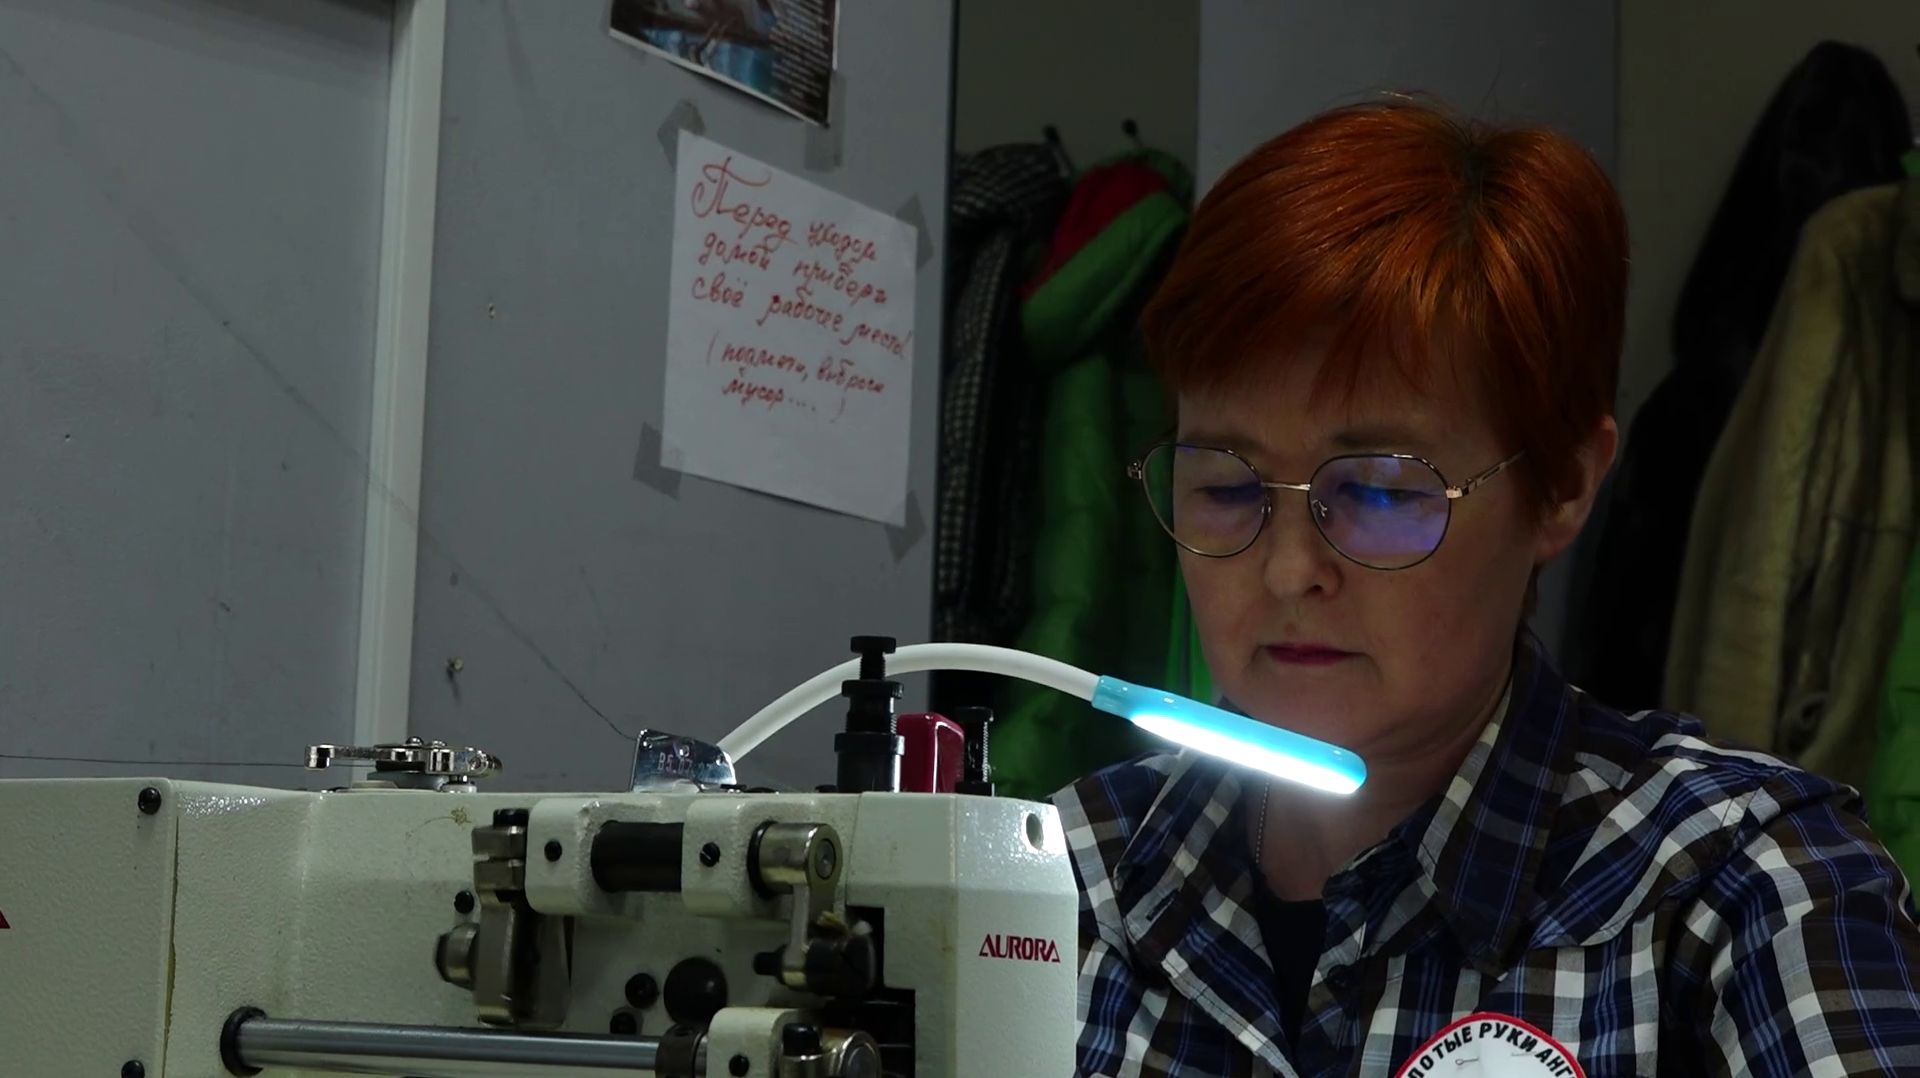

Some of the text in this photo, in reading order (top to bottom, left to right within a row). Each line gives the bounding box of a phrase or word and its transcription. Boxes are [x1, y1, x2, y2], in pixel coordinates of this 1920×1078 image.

[690, 156, 797, 252] Перед
[979, 933, 1062, 964] AURORA
[1478, 1022, 1538, 1052] РУКИ
[1534, 1047, 1576, 1078] АНГ
